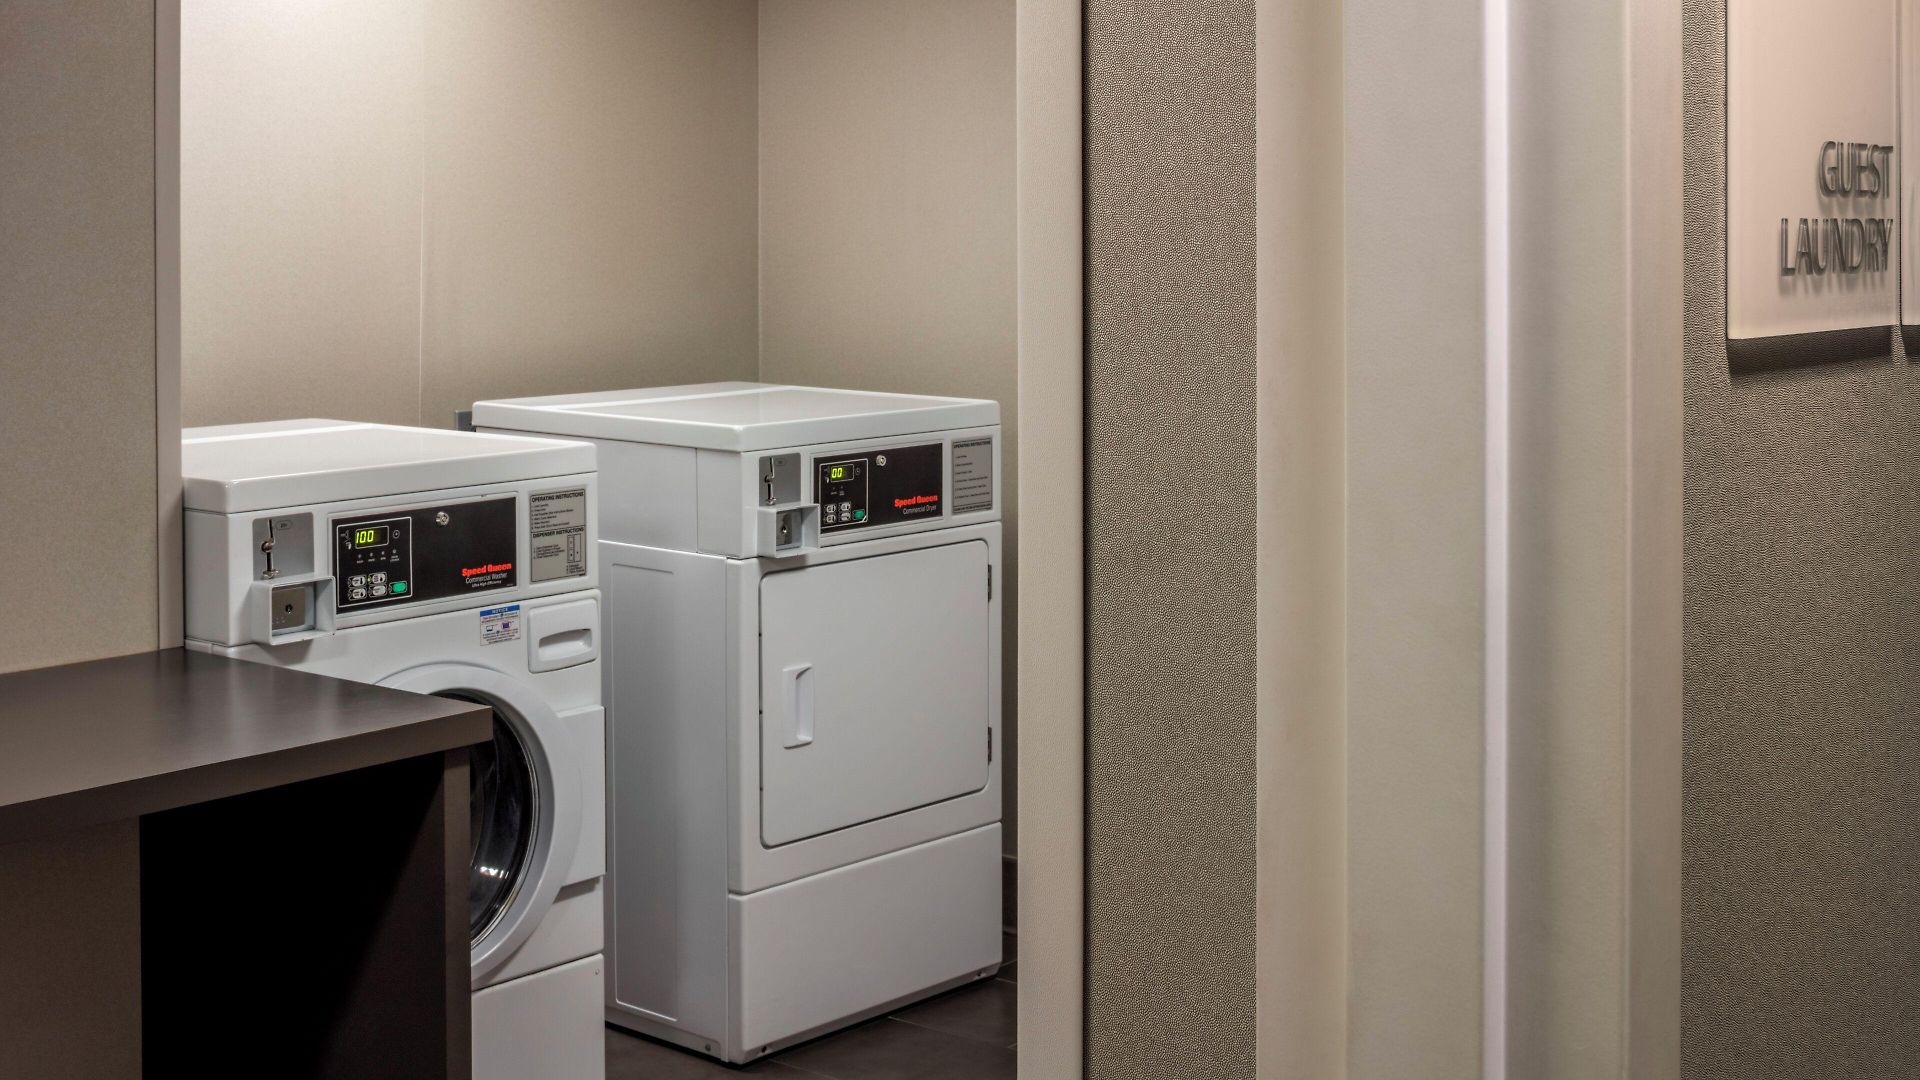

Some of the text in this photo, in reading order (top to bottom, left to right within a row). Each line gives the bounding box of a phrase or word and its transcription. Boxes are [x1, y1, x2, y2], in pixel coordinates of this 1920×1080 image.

[1818, 141, 1893, 197] GUEST
[1780, 218, 1893, 276] LAUNDRY
[531, 491, 584, 503] OPERATING INSTRUCTIONS
[894, 495, 938, 508] Speed Queen
[903, 504, 937, 514] Commercial Dryer
[355, 530, 375, 544] 100
[533, 527, 584, 539] DISPENSER INSTRUCTIONS
[462, 562, 513, 577] Speed Queen
[465, 572, 508, 584] Commercial Washer
